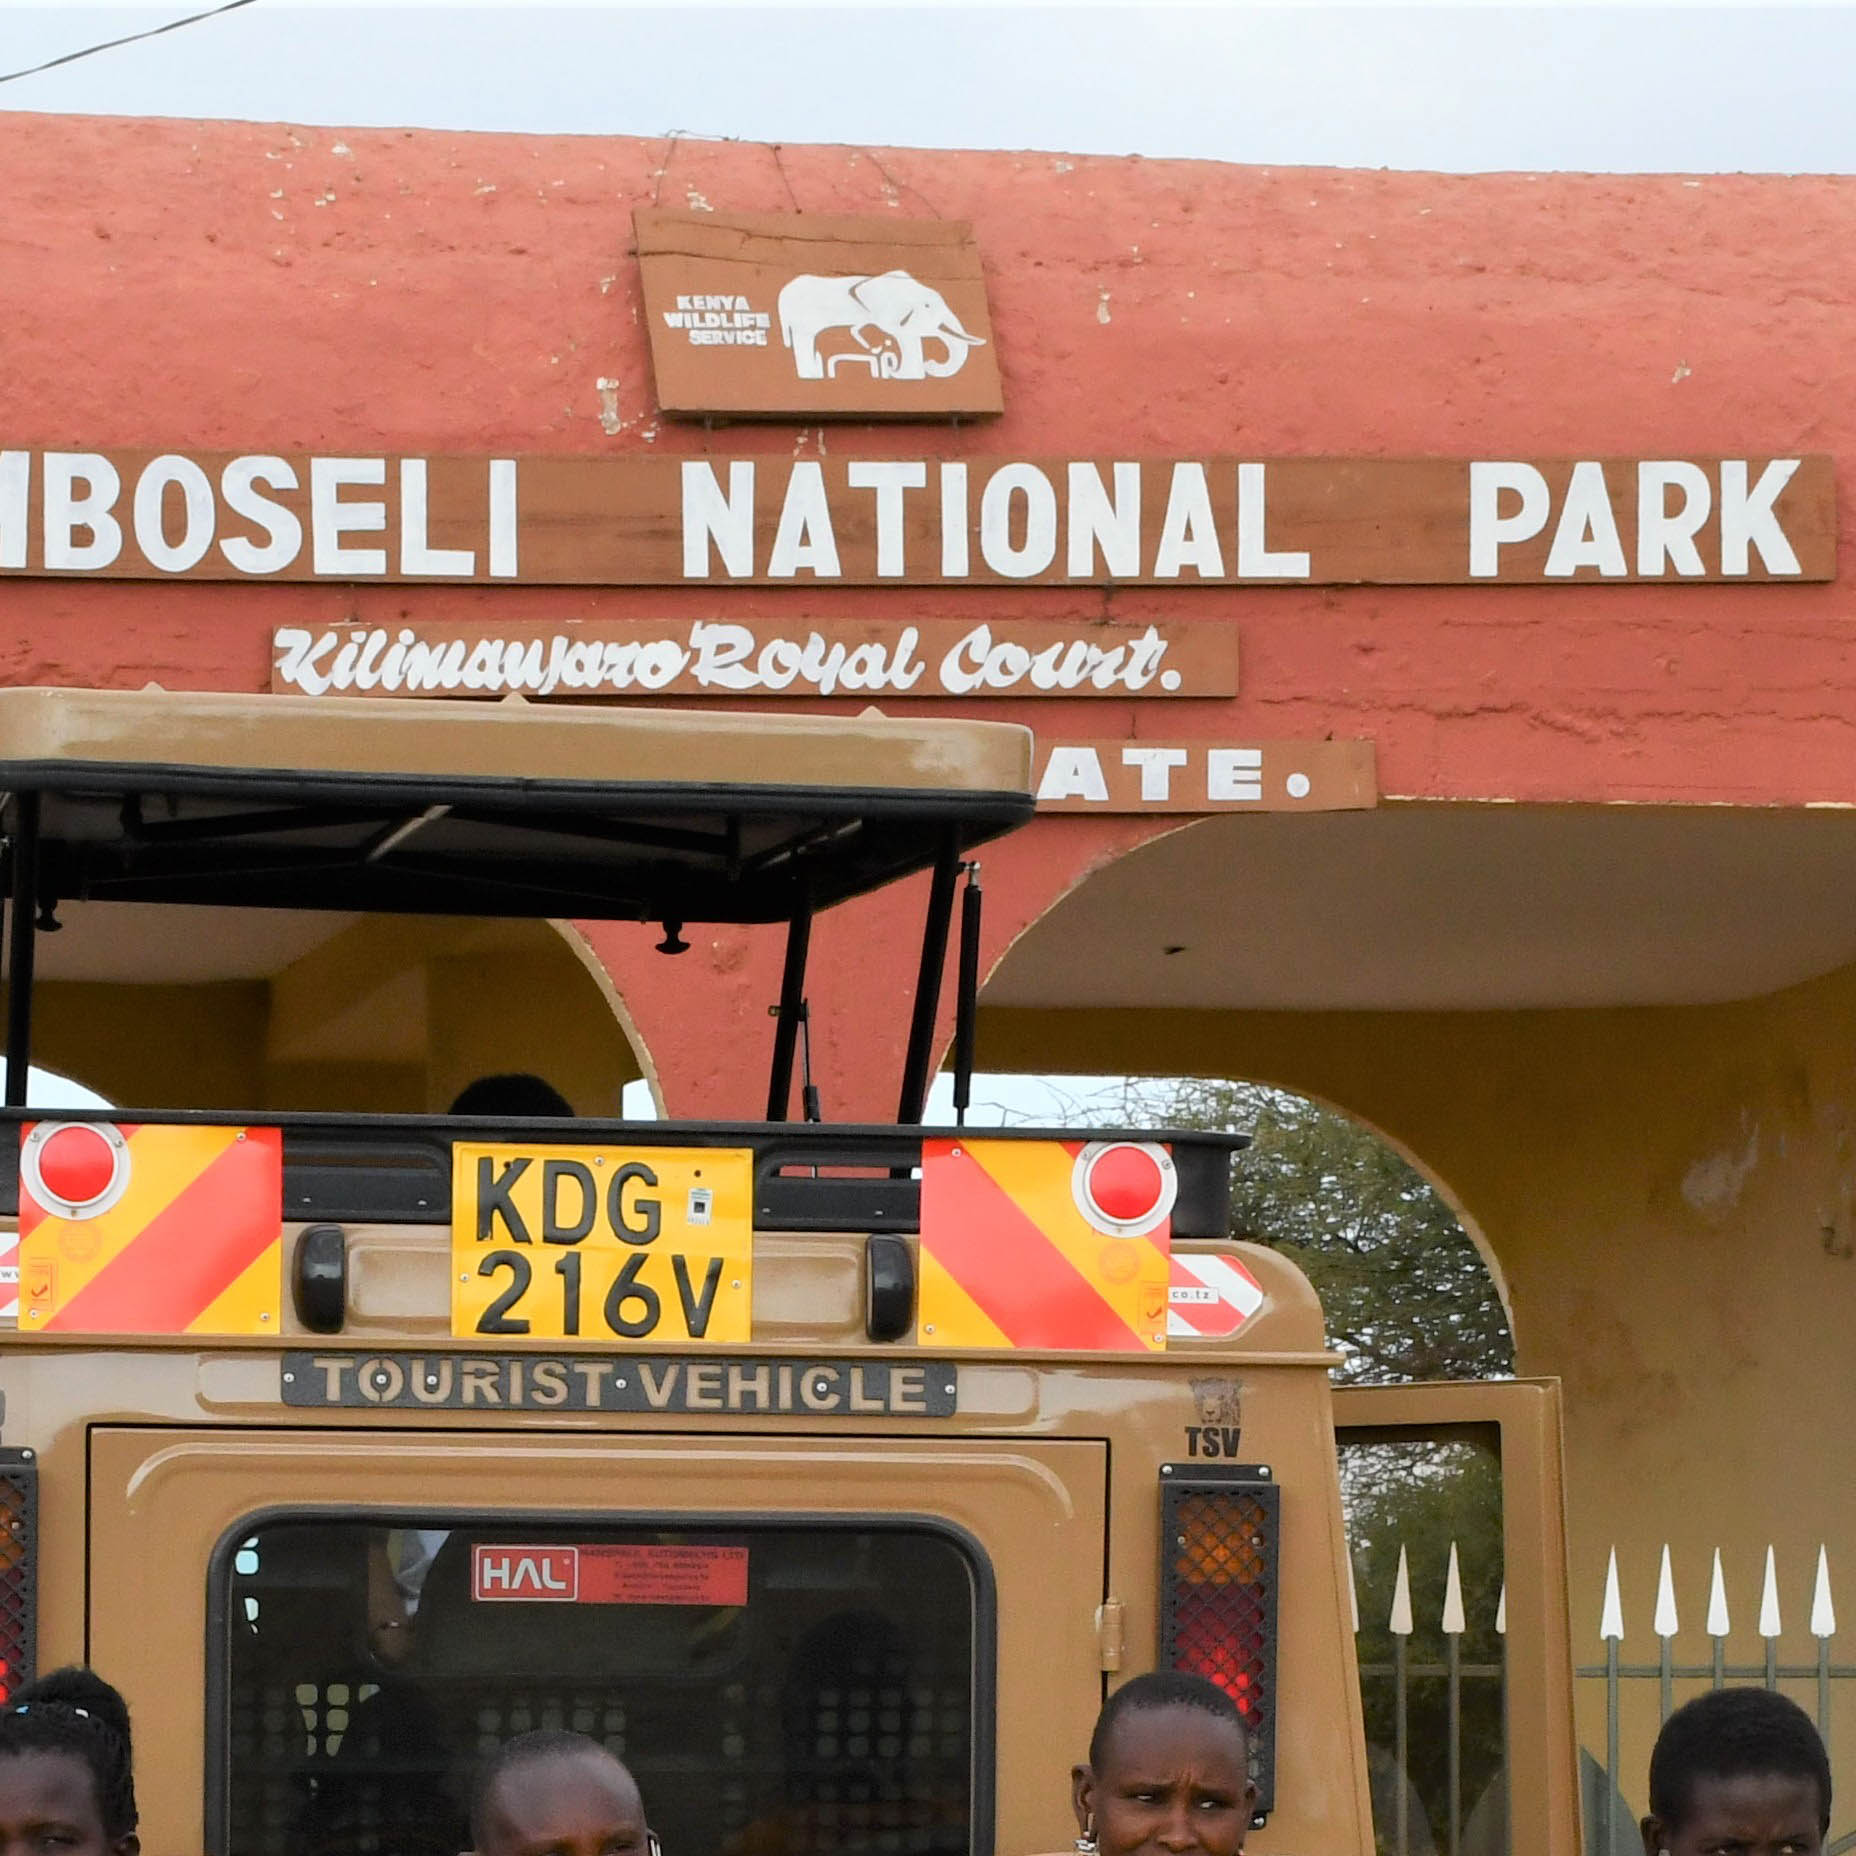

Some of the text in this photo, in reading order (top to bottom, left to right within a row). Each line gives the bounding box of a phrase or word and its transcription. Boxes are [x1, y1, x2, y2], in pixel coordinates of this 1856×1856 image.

[663, 312, 771, 328] WILDLIFE
[676, 295, 751, 310] KENYA
[688, 330, 768, 345] SERVICE
[681, 461, 1311, 578] NATIONAL
[1469, 459, 1803, 577] PARK
[274, 620, 1182, 695] Kilimanjaro Royal Court.
[1037, 746, 1310, 799] ATE.
[475, 1155, 661, 1246] KDG
[475, 1249, 724, 1339] 216V
[313, 1357, 928, 1413] TOURIST VEHICLE
[1184, 1426, 1242, 1458] TSV
[482, 1557, 568, 1590] HAL
